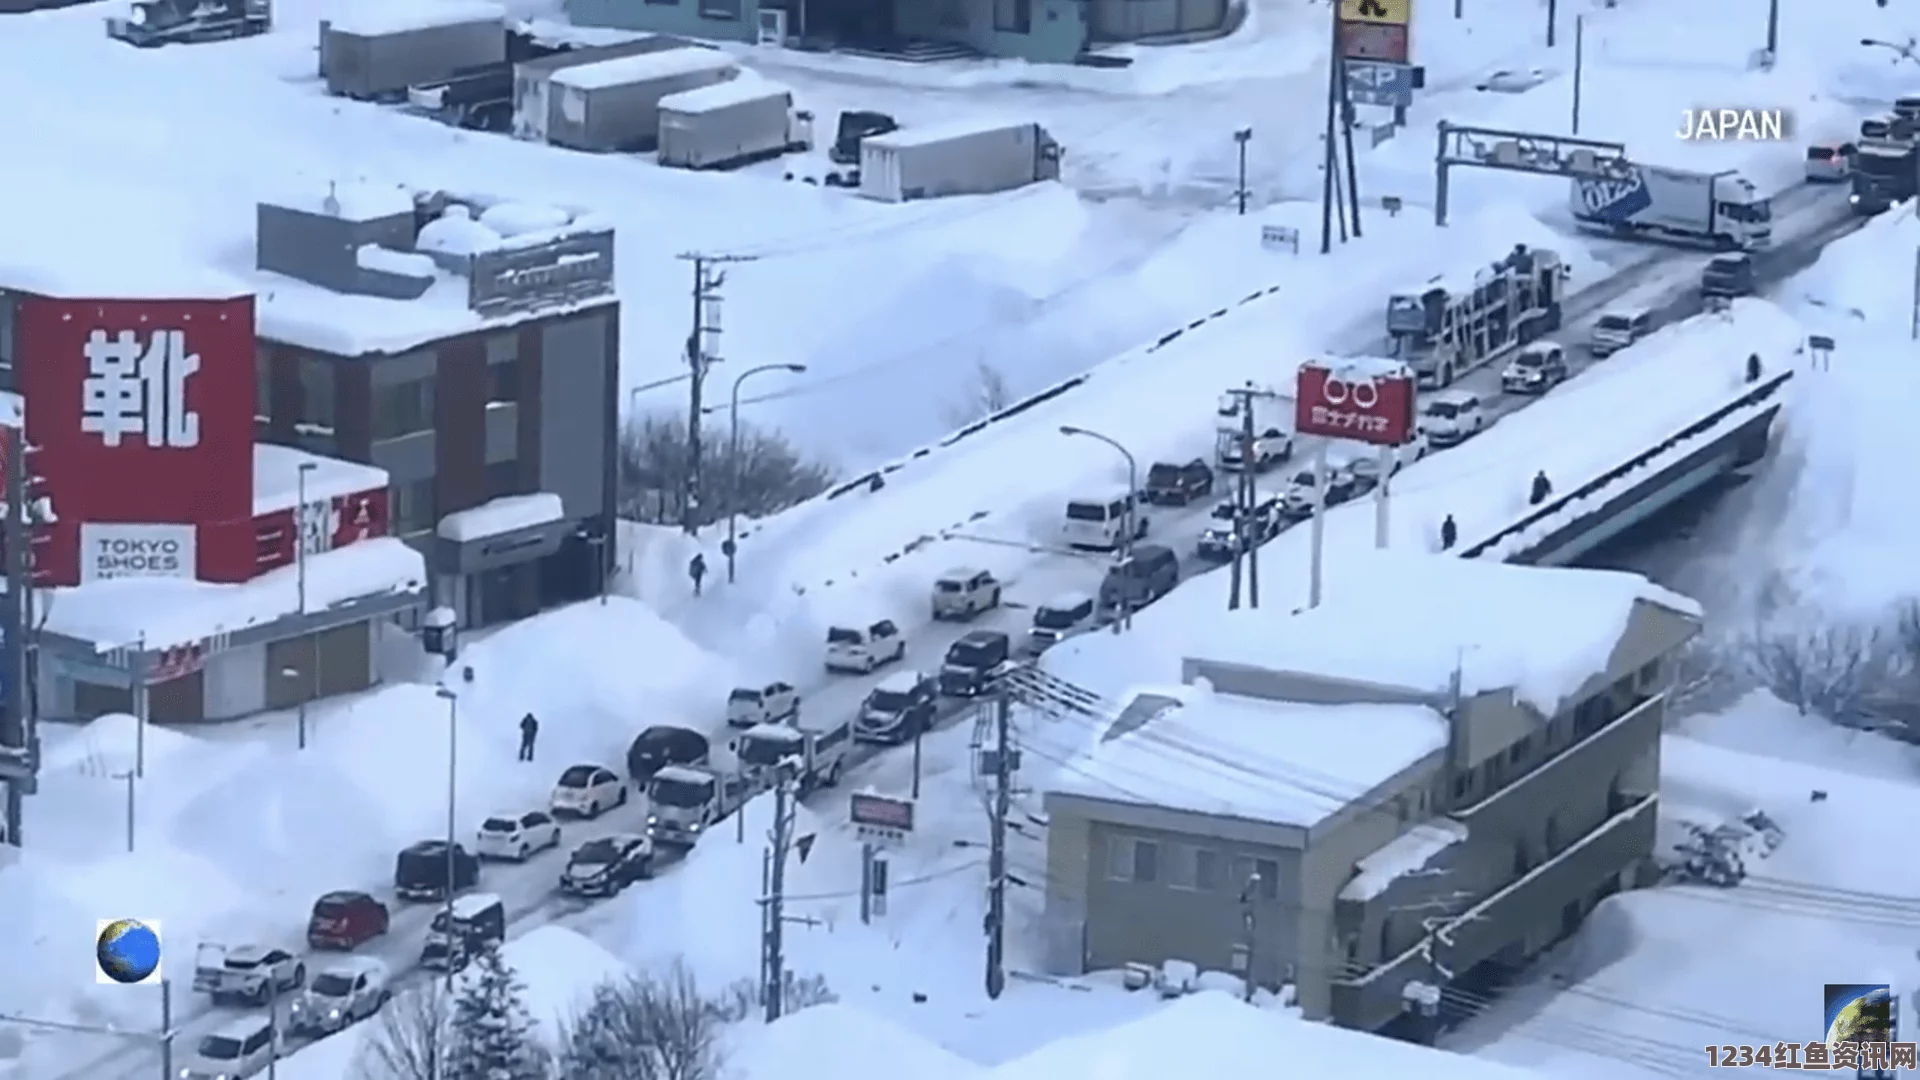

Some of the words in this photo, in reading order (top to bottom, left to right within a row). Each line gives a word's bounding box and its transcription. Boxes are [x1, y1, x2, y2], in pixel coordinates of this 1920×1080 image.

[81, 328, 200, 447] 靴
[98, 539, 179, 554] TOKYO
[97, 555, 179, 570] SHOES
